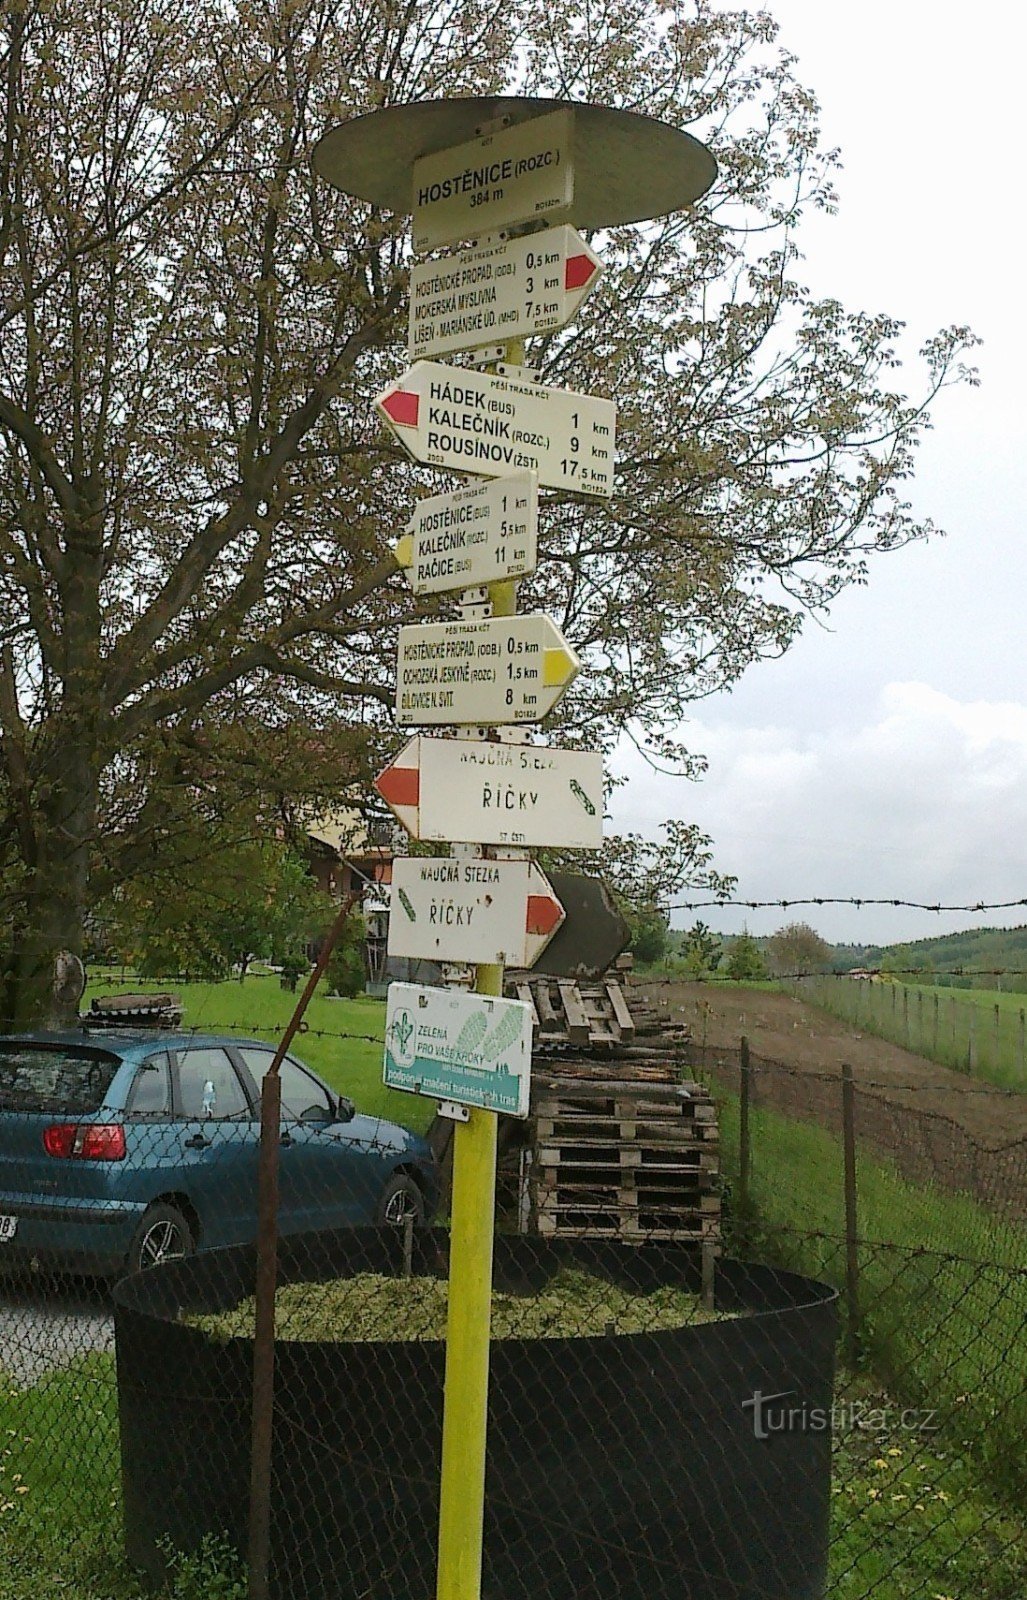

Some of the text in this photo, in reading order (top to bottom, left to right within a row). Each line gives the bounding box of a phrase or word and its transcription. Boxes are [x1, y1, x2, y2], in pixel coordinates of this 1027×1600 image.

[418, 159, 512, 207] HOSTĚNICE
[470, 188, 503, 208] 384 m
[526, 252, 560, 269] 0,5 km
[415, 269, 460, 298] HOSTĚNICKÉ
[526, 277, 559, 294] 3 km
[415, 286, 497, 322] MOKERSKÁ MYSLIVNA
[526, 302, 559, 318] 7,5 km
[414, 322, 435, 345] LÍŠEŇ
[440, 311, 483, 338] MARIÁNSKÉ
[430, 382, 515, 417] HÁDEK (BUS)
[509, 384, 534, 396] TRASA
[429, 407, 550, 450] KALEČNÍK (ROZC.)
[571, 412, 609, 436] 1 km
[428, 432, 514, 465] ROUSÍNOV
[570, 437, 609, 459] 9 km
[560, 459, 608, 483] 17,5 km
[501, 496, 527, 512] 1 km
[420, 505, 473, 533] HOSTĚNICE
[500, 521, 527, 539] 5,5 km
[419, 528, 466, 557] KALEČNÍK
[495, 546, 526, 563] 11 km
[418, 558, 454, 580] RAČICE
[403, 640, 445, 660] HOSTĚNICKÉ
[507, 637, 539, 656] 0,5 km
[403, 662, 438, 685] OCHOZSKÁ
[440, 661, 469, 683] JESKYNĚ
[507, 662, 538, 681] 1,5 km
[506, 688, 537, 705] 8 km
[483, 782, 538, 810] ŘÍČKY
[420, 861, 500, 883] NAUČNÁ STEZKA
[430, 898, 474, 925] ŘÍČKY
[418, 1024, 448, 1040] ZELENÁ
[418, 1042, 434, 1055] PRO
[456, 1049, 485, 1065] KROKY
